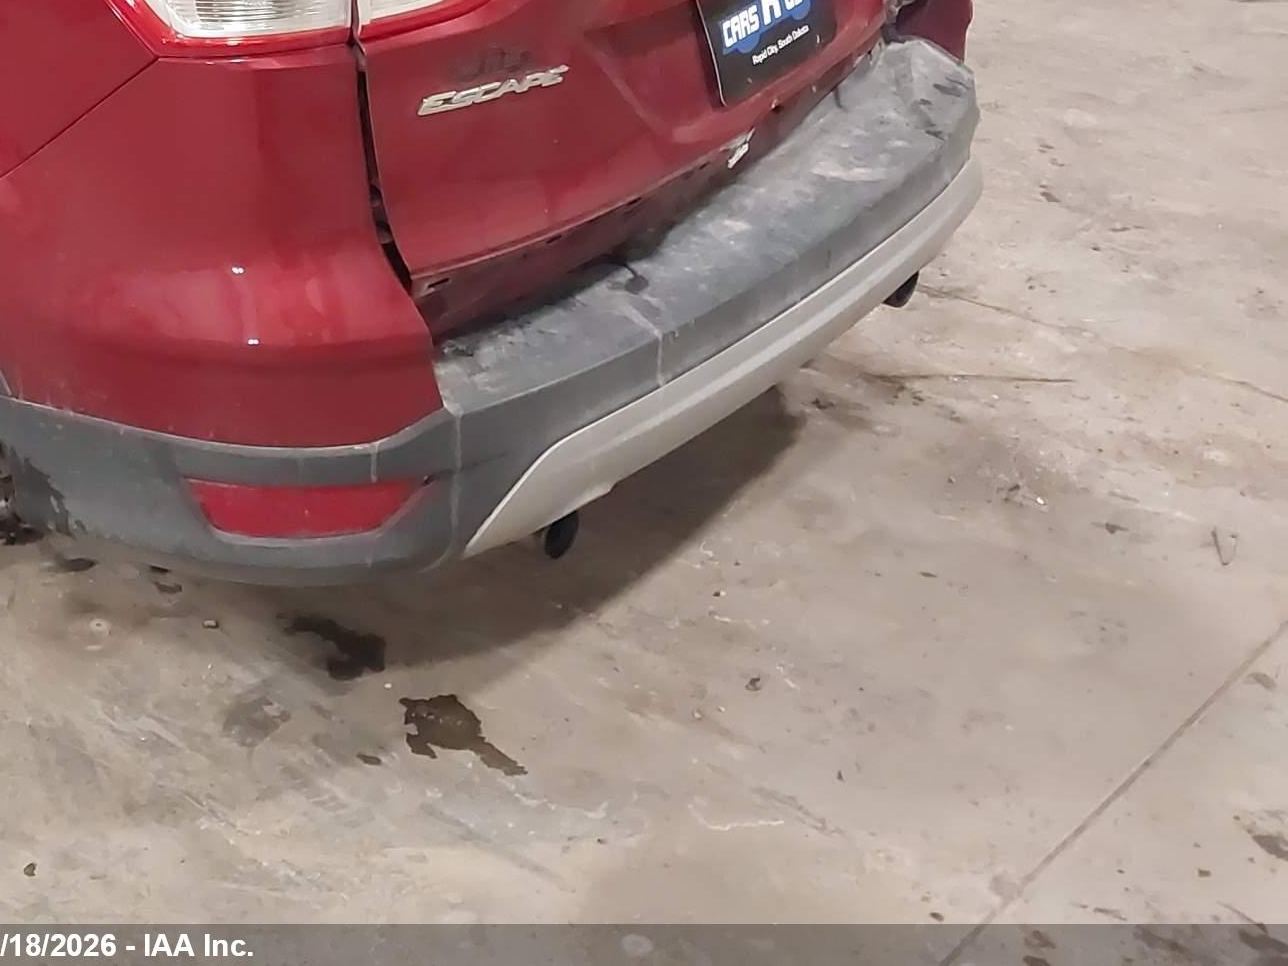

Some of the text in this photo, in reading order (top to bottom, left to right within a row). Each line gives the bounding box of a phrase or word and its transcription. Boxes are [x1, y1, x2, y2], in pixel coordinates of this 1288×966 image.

[721, 4, 761, 48] CARS
[752, 49, 768, 65] Rapid
[777, 33, 793, 49] South
[791, 24, 811, 41] Dakota
[417, 64, 570, 116] ESCAPE
